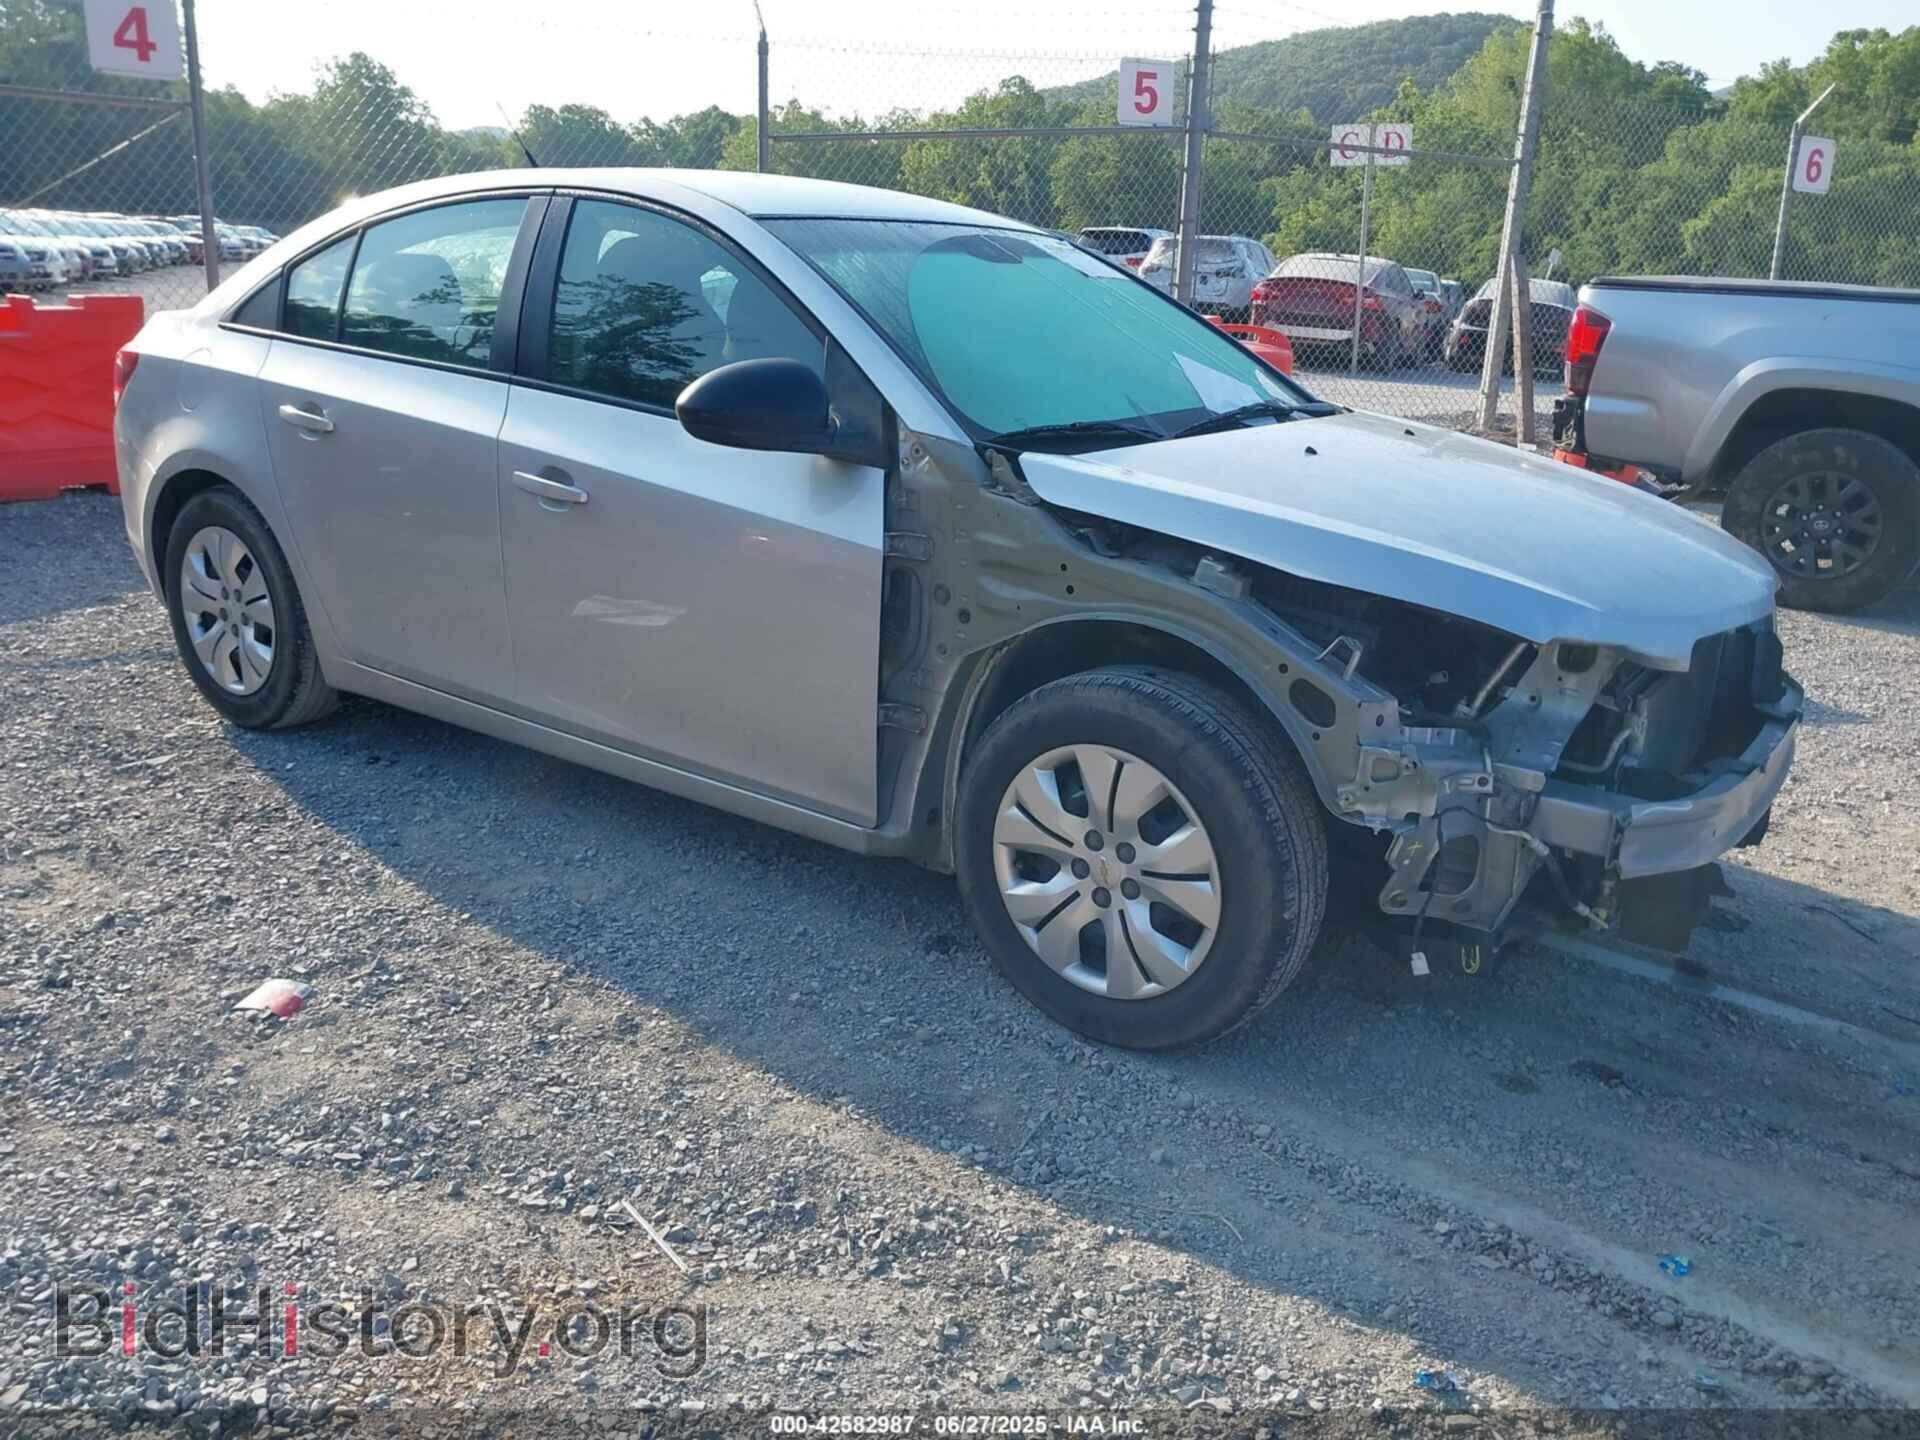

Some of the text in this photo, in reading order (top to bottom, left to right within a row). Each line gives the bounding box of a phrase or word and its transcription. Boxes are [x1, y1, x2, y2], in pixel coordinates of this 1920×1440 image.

[113, 7, 157, 62] 4
[1134, 71, 1158, 115] 5
[1382, 131, 1405, 159] D
[1806, 148, 1824, 183] 6
